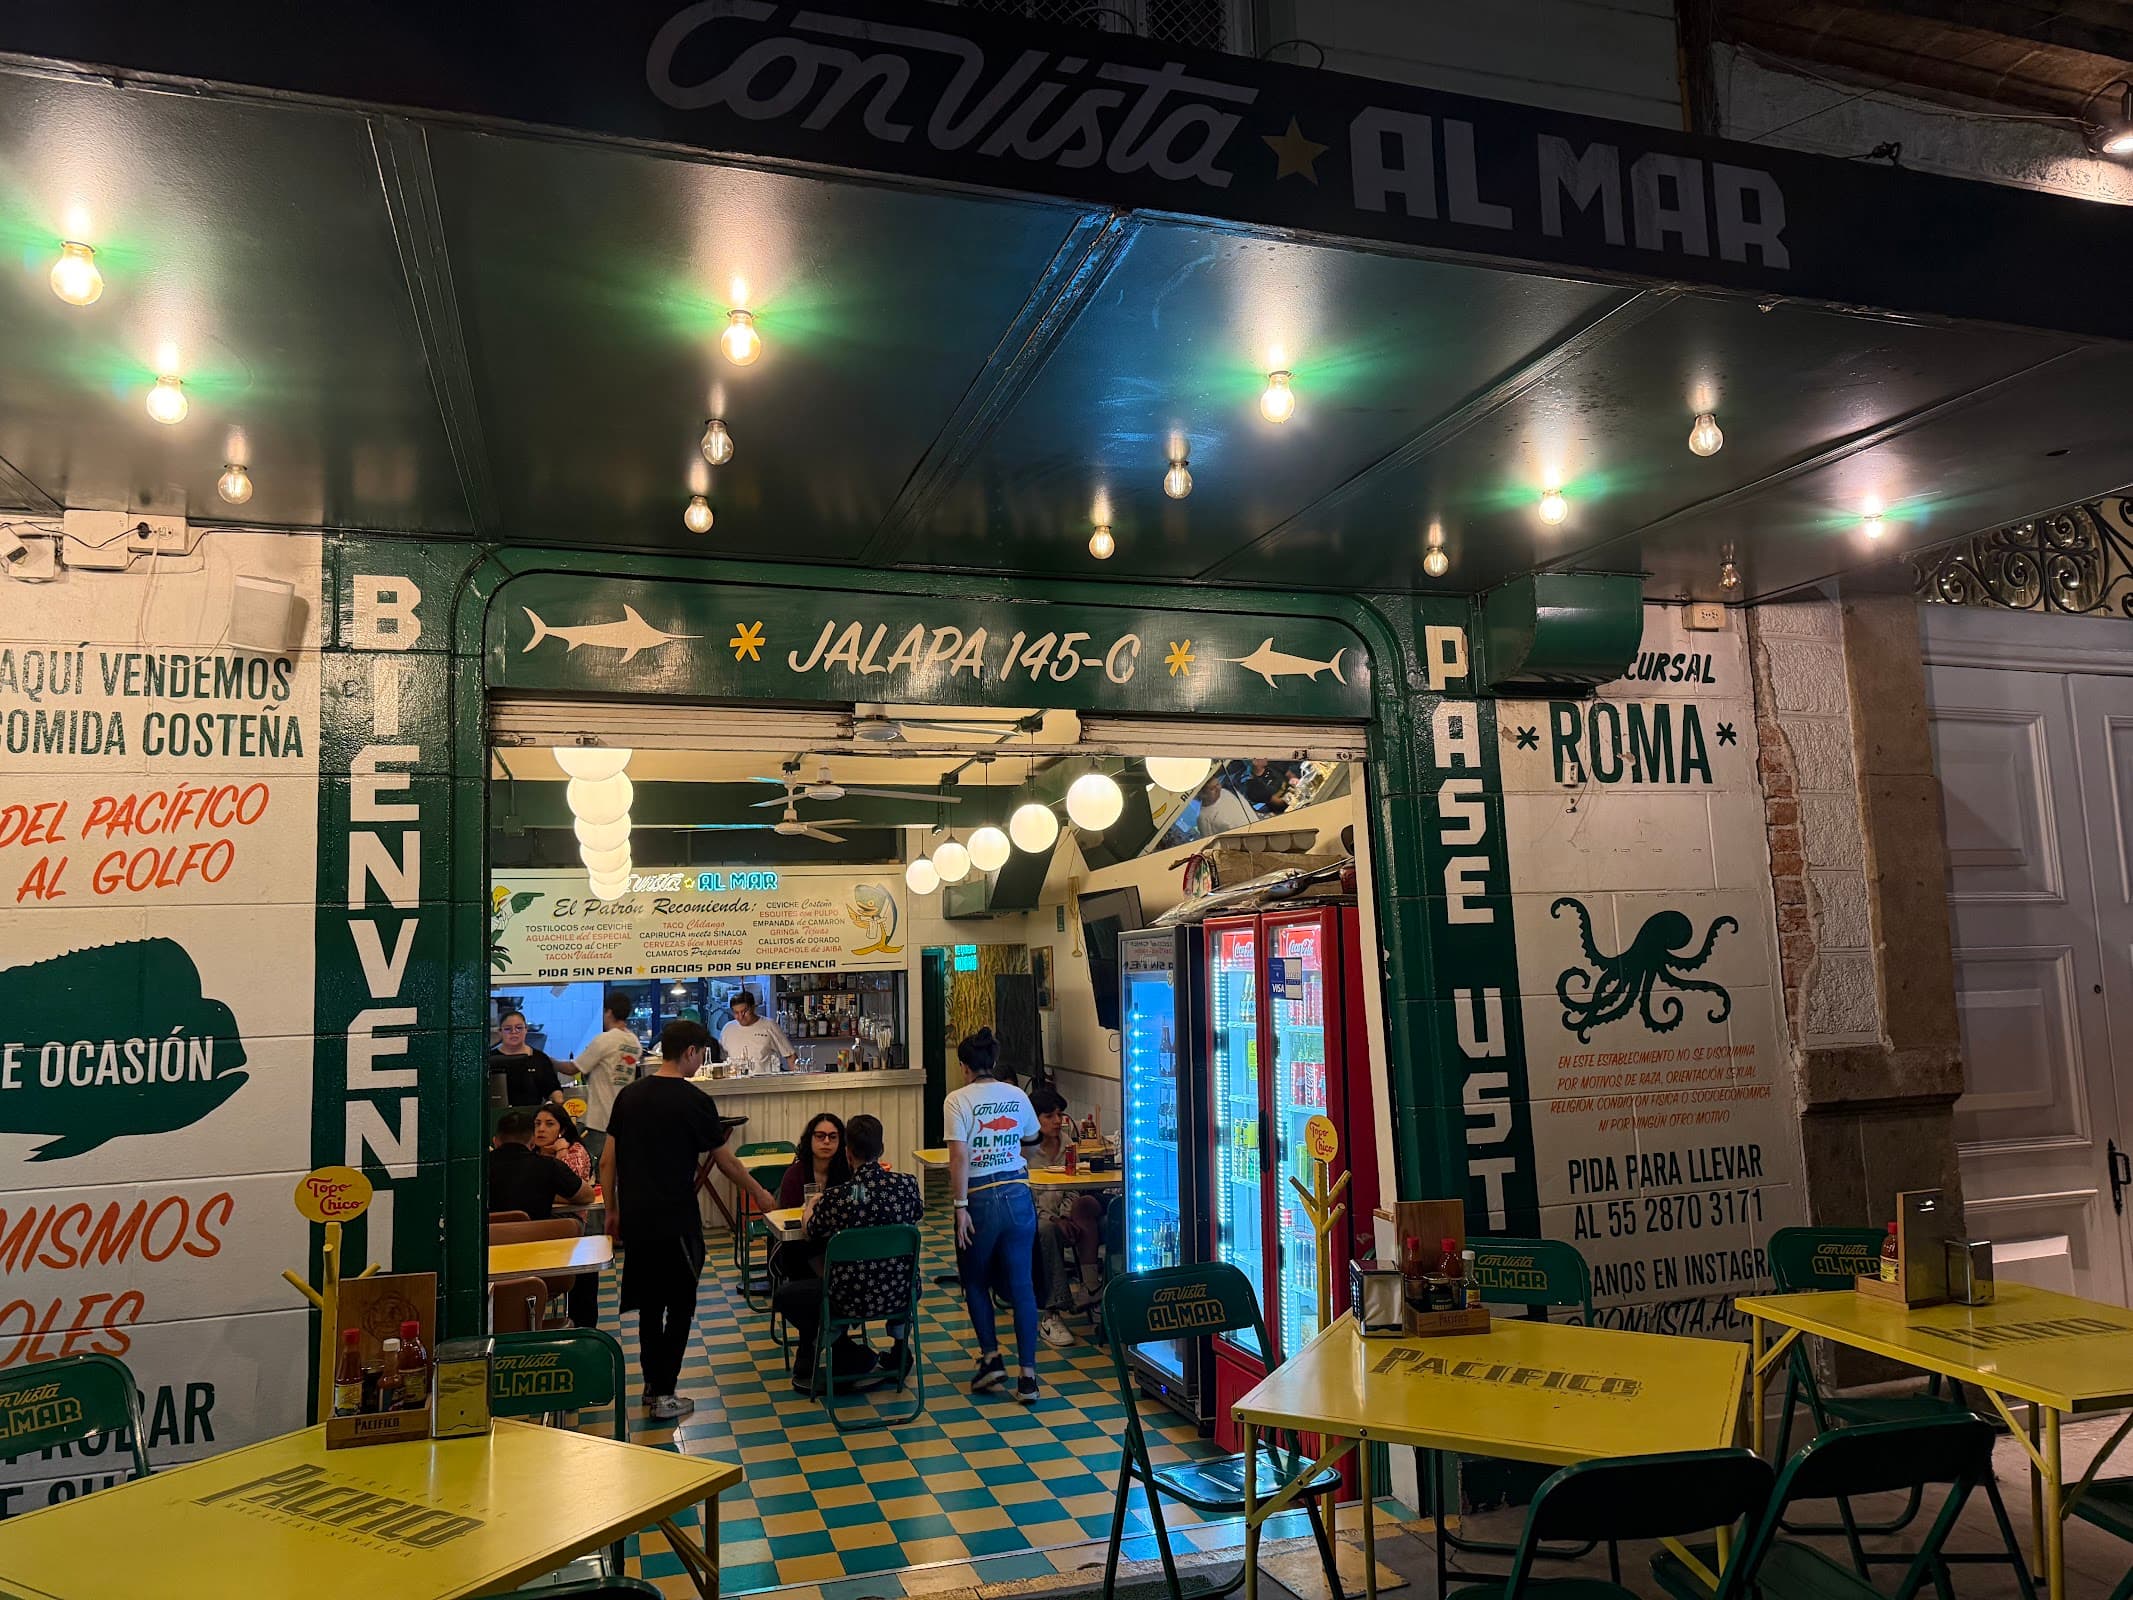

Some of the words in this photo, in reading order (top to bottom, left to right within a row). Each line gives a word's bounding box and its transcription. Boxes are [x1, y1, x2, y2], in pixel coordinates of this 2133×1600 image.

[1349, 105, 1513, 230] AL
[1537, 132, 1790, 269] MAR
[789, 620, 984, 681] JALAPA
[1000, 629, 1142, 684] 145-C
[0, 641, 89, 702] AQUÍ
[100, 652, 292, 701] VENDEMOS
[1616, 652, 1716, 684] CURSAL
[0, 708, 126, 756] OMIDA
[142, 704, 304, 759] COSTEÑA
[1549, 700, 1714, 785] ROMA
[1424, 624, 1495, 925] PASE
[0, 800, 68, 848] DEL
[81, 782, 270, 840] PACÍFICO
[17, 856, 68, 902] AL
[92, 838, 235, 895] GOLFO
[698, 871, 726, 891] AL
[730, 871, 778, 891] MAR
[553, 898, 578, 917] El
[584, 897, 644, 917] Patrón
[652, 897, 758, 916] Recomienda:
[759, 910, 798, 918] ESQUITES
[814, 909, 839, 917] PULPO
[766, 901, 799, 909] CEVICHE
[526, 924, 579, 933] TOSTILOCOS
[596, 923, 633, 931] CEVICHE
[753, 919, 795, 927] EMPANADA
[770, 928, 800, 936] GRINGA
[526, 933, 574, 942] AGUACHILE
[592, 932, 632, 940] ESPECIAL
[639, 931, 687, 939] CAPIRUCHA
[713, 929, 747, 937] SINALOA
[643, 940, 685, 949] CERVEZAS
[705, 939, 743, 947] MUERTAS
[758, 937, 795, 945] CALLITOS
[808, 936, 840, 944] DORADO
[573, 950, 613, 961] Vallarta
[645, 950, 689, 958] CLAMATOS
[756, 947, 809, 955] CHILPACHOLE
[538, 967, 569, 978] PIDA
[573, 967, 594, 976] SIN
[598, 966, 633, 975] PENA
[651, 964, 703, 974] GRACIAS
[708, 963, 731, 972] POR
[736, 962, 751, 971] SU
[755, 960, 836, 971] PREFERENCIA
[1272, 983, 1285, 993] VISA
[39, 1026, 215, 1087] OCASIÓN
[1558, 1055, 1572, 1069] EN
[1572, 1054, 1595, 1068] ESTE
[1597, 1049, 1675, 1067] ESTABLECIMIENTO
[1677, 1048, 1691, 1061] NO
[1693, 1047, 1704, 1060] SE
[1557, 1077, 1577, 1090] POR
[1580, 1073, 1623, 1089] MOTIVOS
[1624, 1073, 1638, 1086] DE
[1310, 1121, 1329, 1138] Topo
[1610, 1117, 1630, 1130] POR
[1669, 1113, 1693, 1126] OTRO
[1695, 1110, 1730, 1124] MOTIVO
[973, 1135, 990, 1147] AL
[993, 1133, 1019, 1147] MAR
[1315, 1137, 1335, 1155] Chico
[1568, 1155, 1619, 1195] PIDA
[1626, 1149, 1682, 1190] PARA
[1688, 1143, 1764, 1184] LLEVAR
[306, 1177, 352, 1198] Topo
[319, 1194, 364, 1216] Chico
[1574, 1204, 1602, 1241] AL
[1608, 1200, 1636, 1237] 55
[1646, 1192, 1702, 1233] 2870
[1710, 1187, 1763, 1227] 3171
[1653, 1256, 1678, 1290] EN
[1685, 1247, 1772, 1287] INSTAGR
[1811, 1256, 1840, 1276] AL
[1499, 1268, 1548, 1290] MAR
[1147, 1304, 1178, 1332] AL
[1175, 1299, 1226, 1328] MAR
[494, 1372, 511, 1398] L
[512, 1368, 574, 1397] MAR
[8, 1396, 83, 1436] MAR
[190, 1463, 487, 1549] PACIFICO
